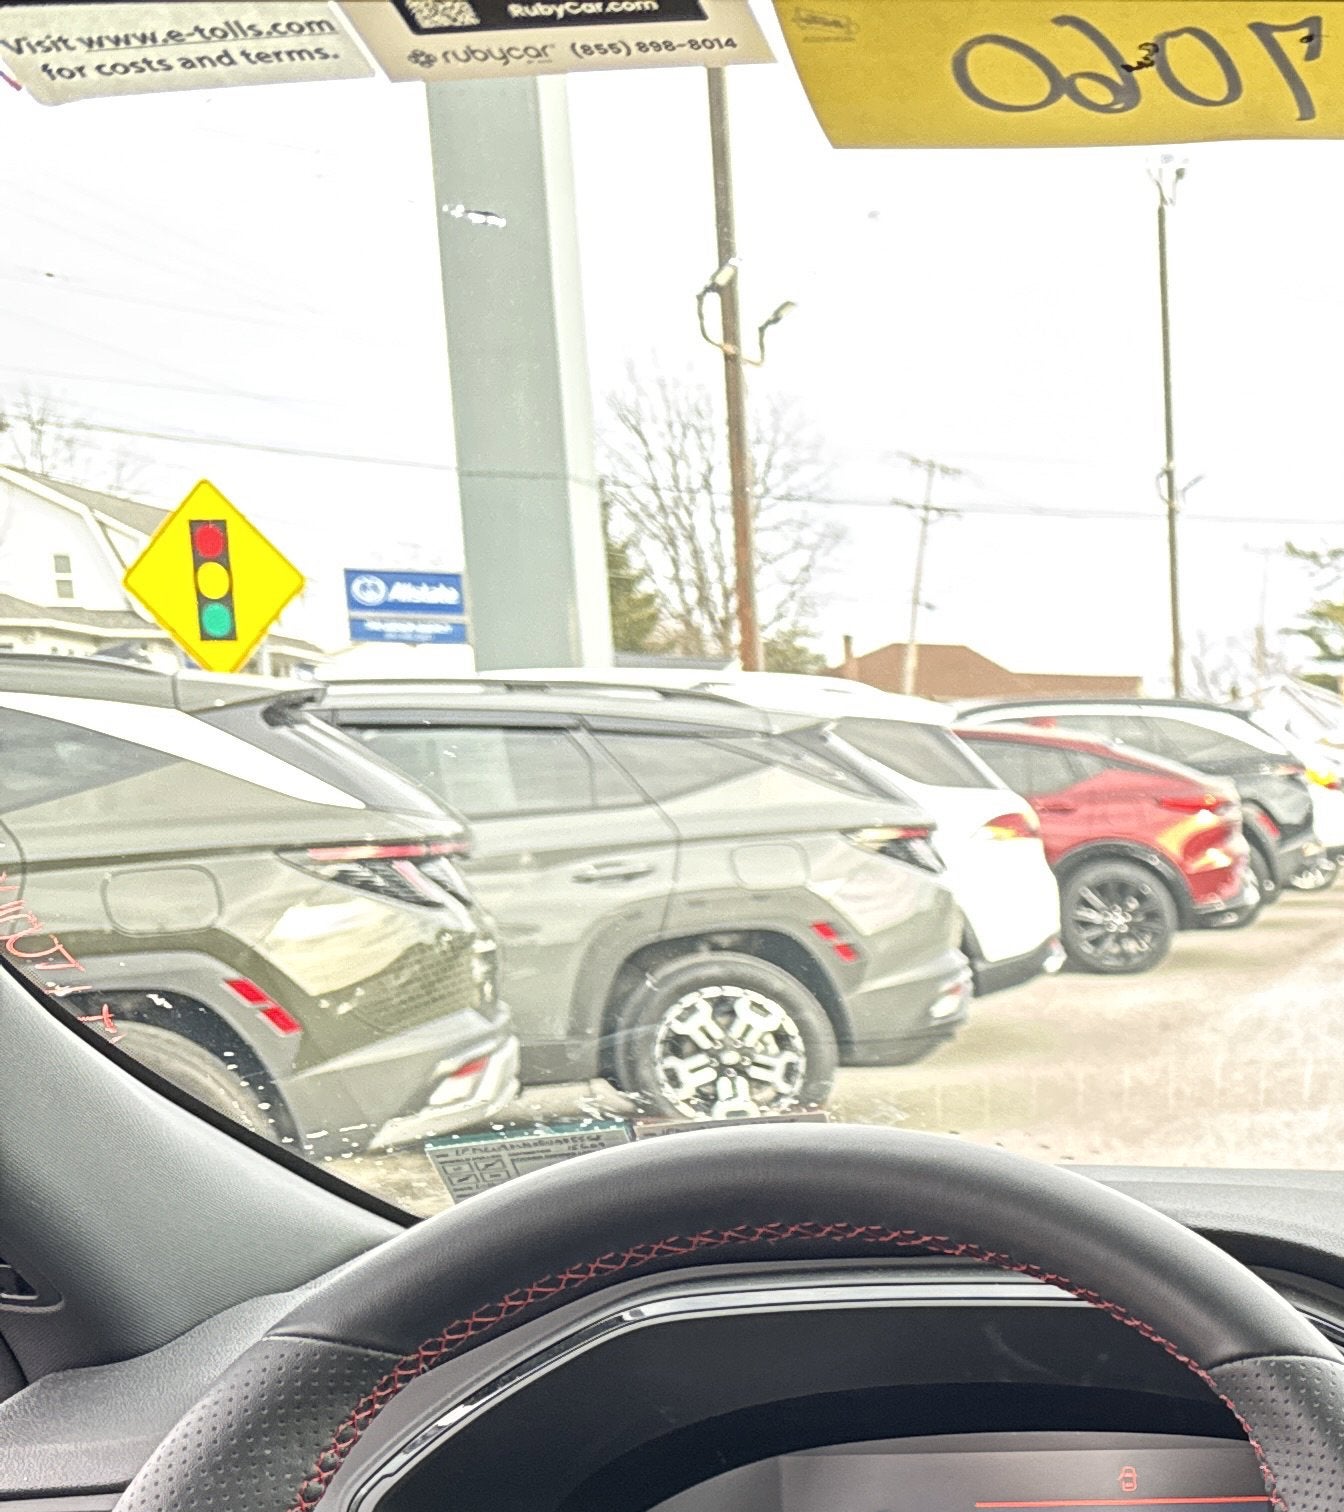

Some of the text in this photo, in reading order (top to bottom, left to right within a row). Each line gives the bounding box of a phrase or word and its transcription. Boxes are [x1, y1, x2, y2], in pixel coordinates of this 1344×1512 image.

[1, 18, 337, 56] Visit www.e-tolls.com
[441, 37, 738, 66] rubycar (855) 898-8014
[41, 44, 339, 82] for costs and terms.
